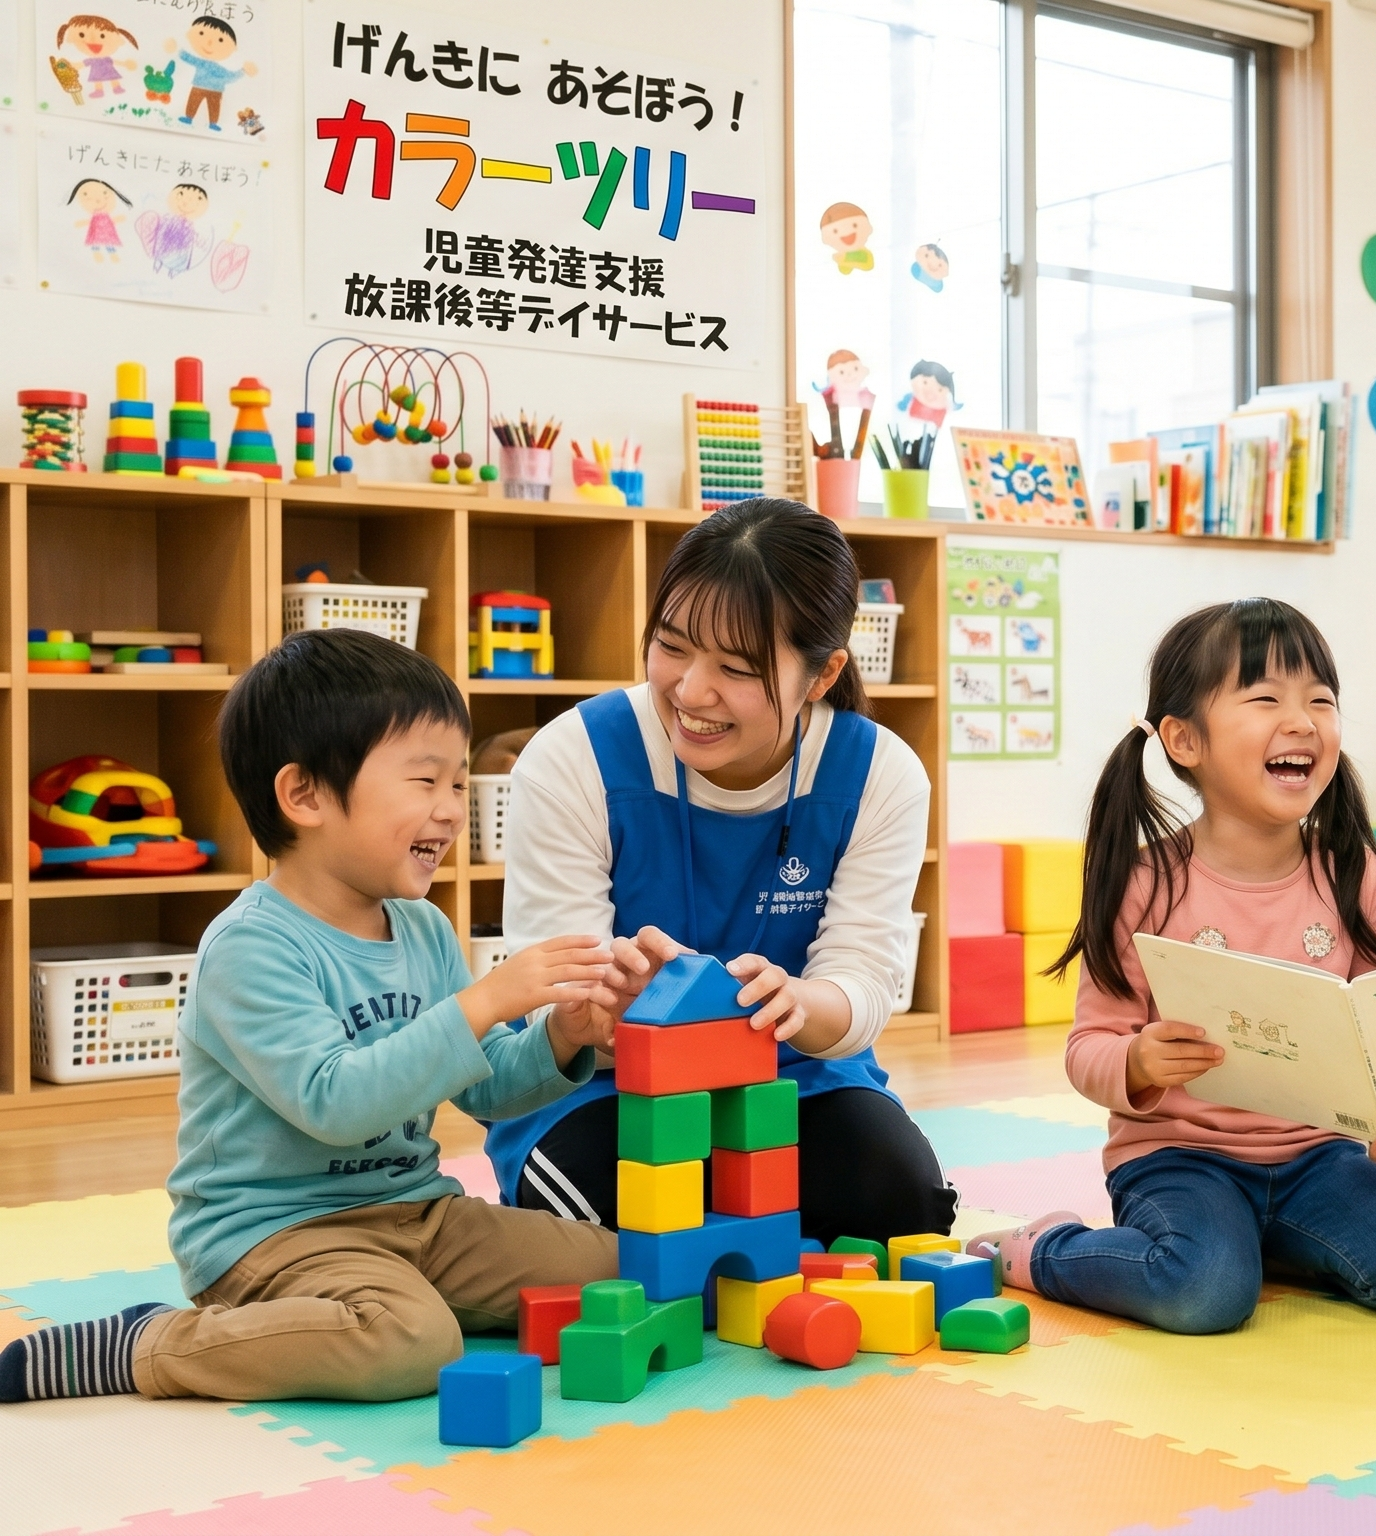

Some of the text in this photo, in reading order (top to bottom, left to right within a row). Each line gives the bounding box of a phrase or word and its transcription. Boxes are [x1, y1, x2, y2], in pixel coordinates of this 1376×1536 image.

[332, 20, 745, 133] げんきに あそぼう！
[316, 98, 756, 242] カラーツリー
[422, 227, 666, 299] 児童発達支援
[344, 272, 730, 353] 放課後等デイサービス
